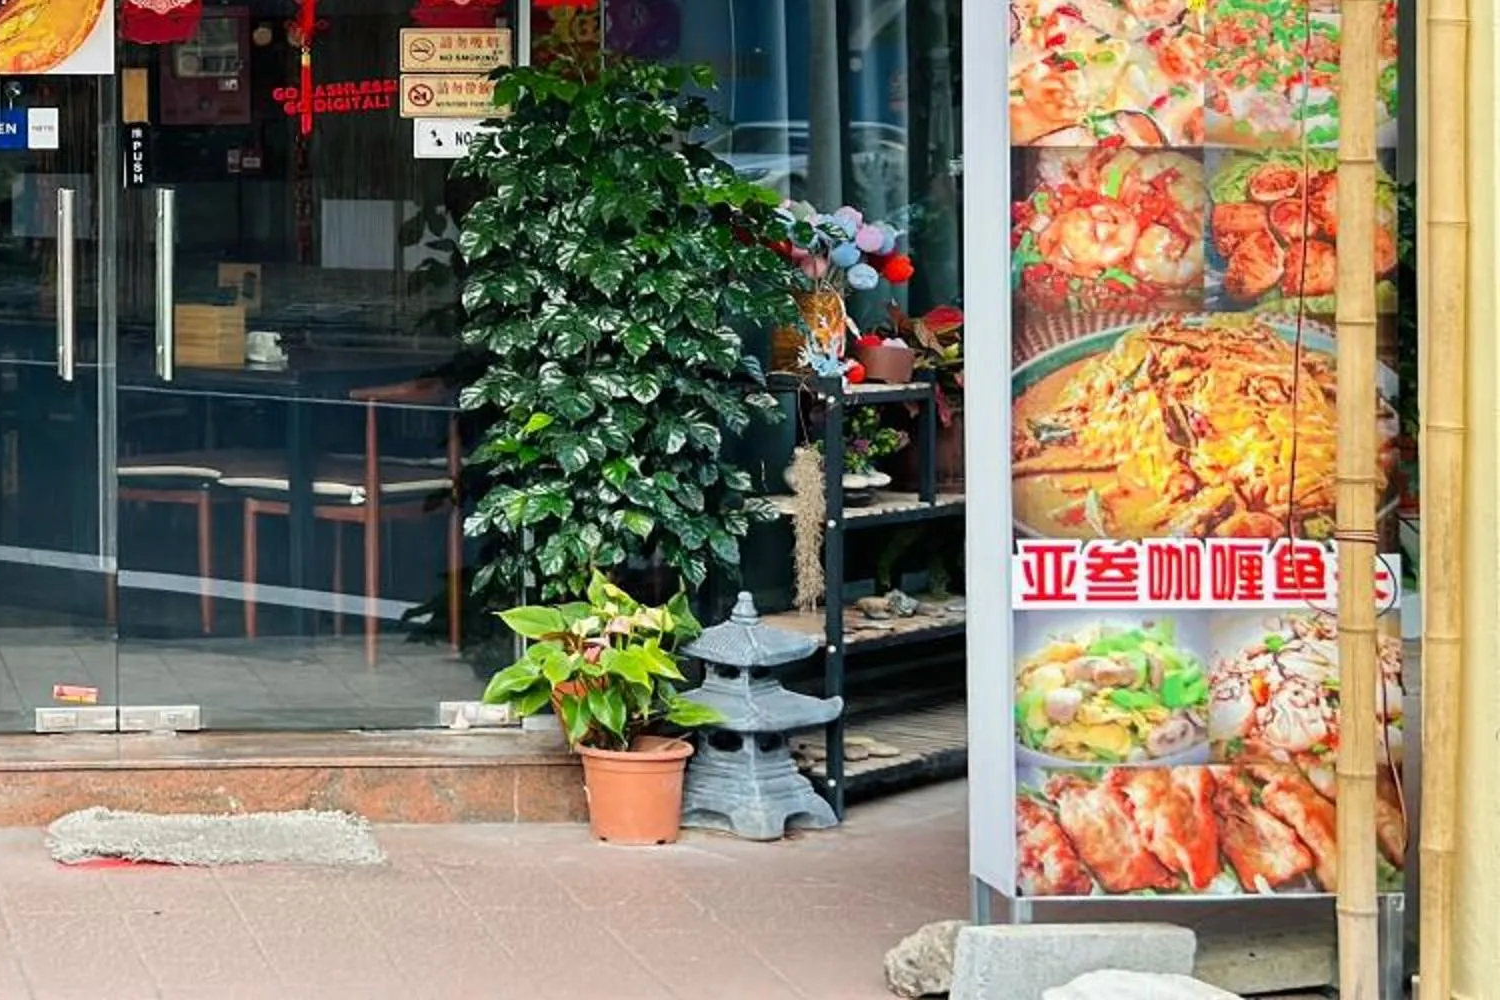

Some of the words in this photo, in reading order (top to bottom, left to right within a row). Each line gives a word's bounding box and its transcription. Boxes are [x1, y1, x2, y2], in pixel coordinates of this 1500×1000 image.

[272, 87, 298, 101] GO
[313, 79, 397, 98] ASHLESS!
[133, 141, 144, 184] PUSH
